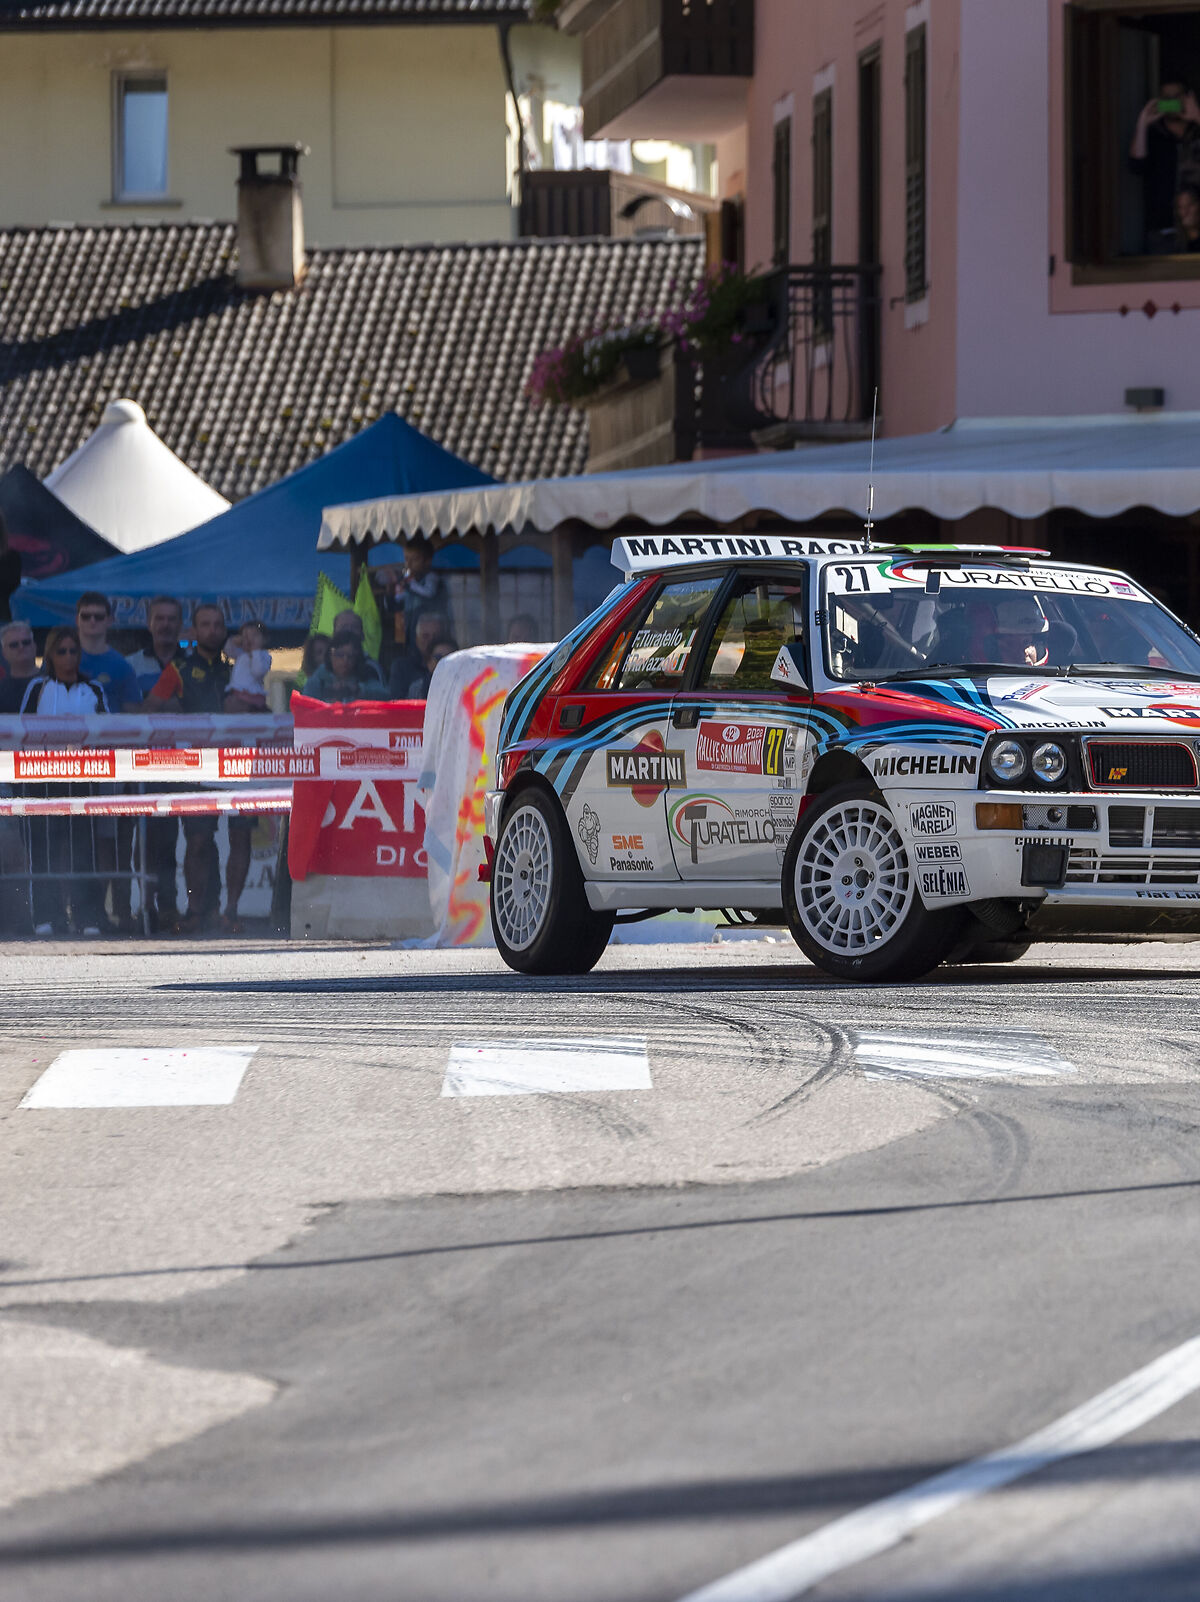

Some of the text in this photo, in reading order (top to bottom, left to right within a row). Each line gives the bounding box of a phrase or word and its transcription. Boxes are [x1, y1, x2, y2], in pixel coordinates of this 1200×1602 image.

[627, 538, 772, 556] MARTINI
[834, 566, 870, 592] 27
[1020, 720, 1107, 728] MICHELIN
[746, 727, 764, 740] 2022
[697, 734, 762, 766] RALLYE SAN MARTINO
[766, 728, 783, 775] 27
[20, 760, 111, 775] DANGEROUS AREA
[288, 759, 315, 774] AREA
[611, 756, 682, 781] MARTINI
[873, 755, 977, 777] MICHELIN
[612, 835, 644, 850] SME
[377, 845, 406, 867] DI
[916, 845, 960, 859] WEBER
[610, 857, 654, 871] Panasonic
[1136, 890, 1170, 899] Fiat
